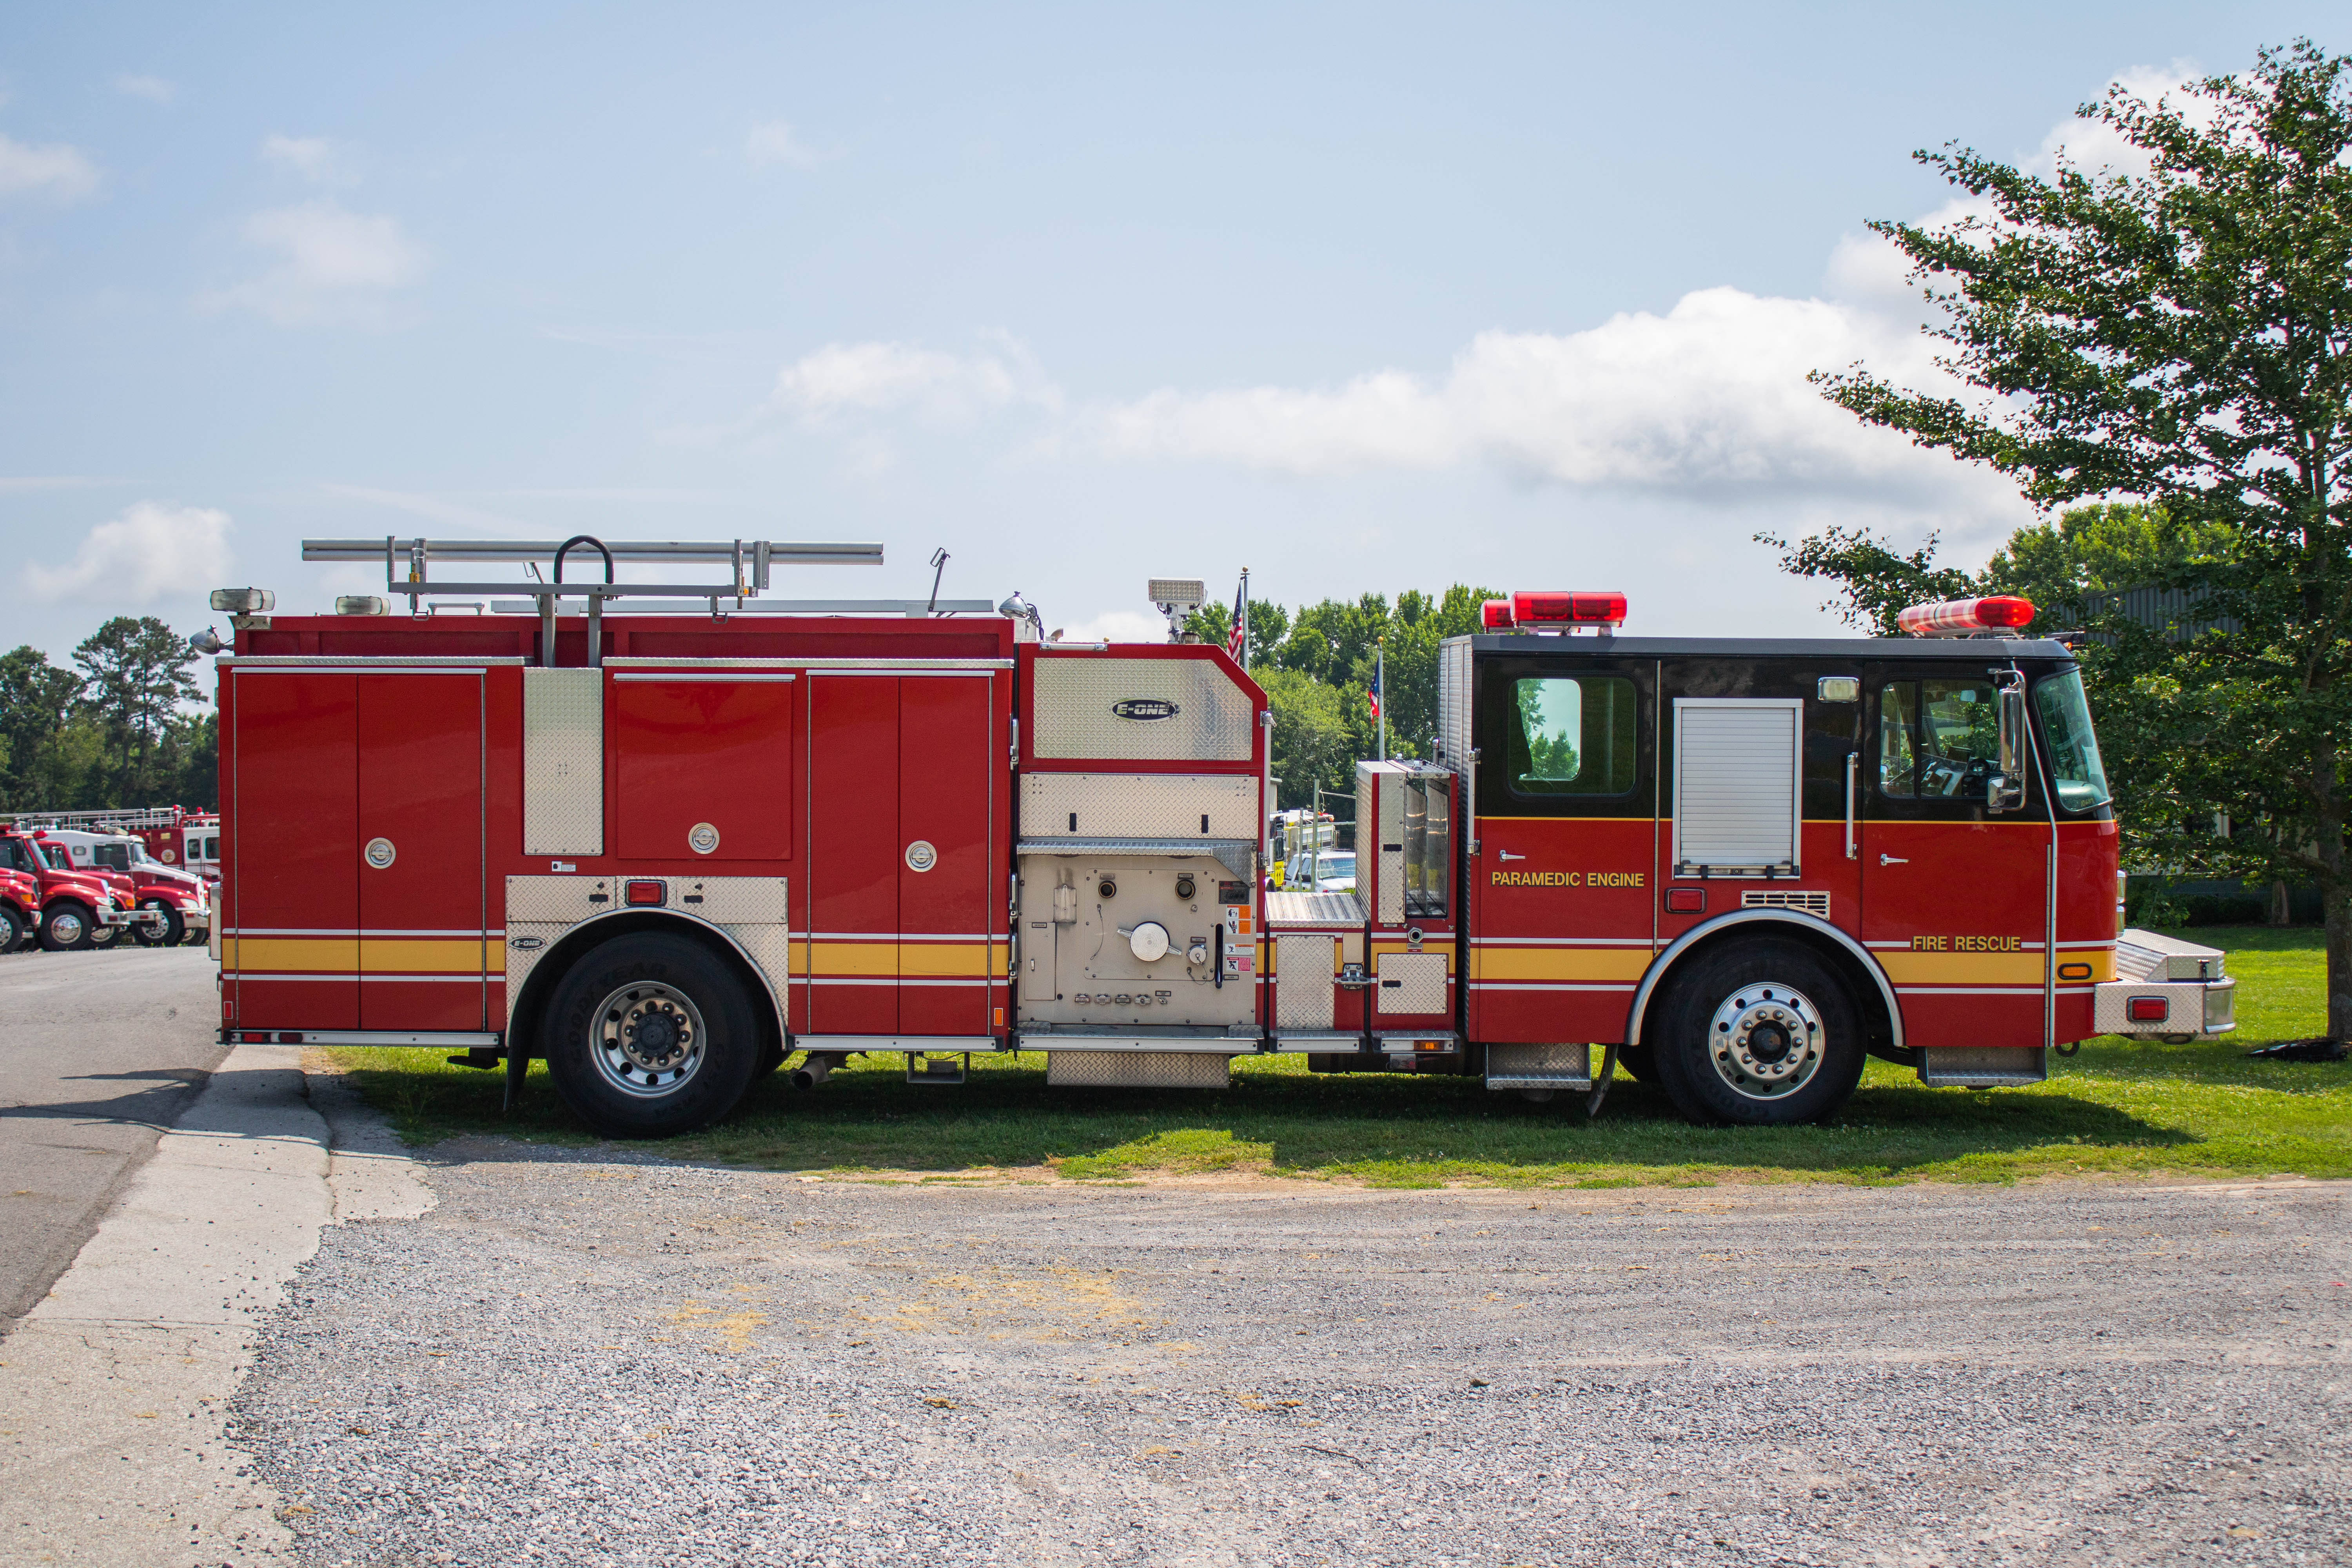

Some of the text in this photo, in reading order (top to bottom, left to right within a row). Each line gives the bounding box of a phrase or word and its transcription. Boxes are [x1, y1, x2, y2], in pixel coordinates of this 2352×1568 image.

[1116, 704, 1169, 715] E-ONE
[1491, 872, 1644, 887] PARAMEDIC ENGINE
[1913, 936, 2020, 951] FIRE RESCUE
